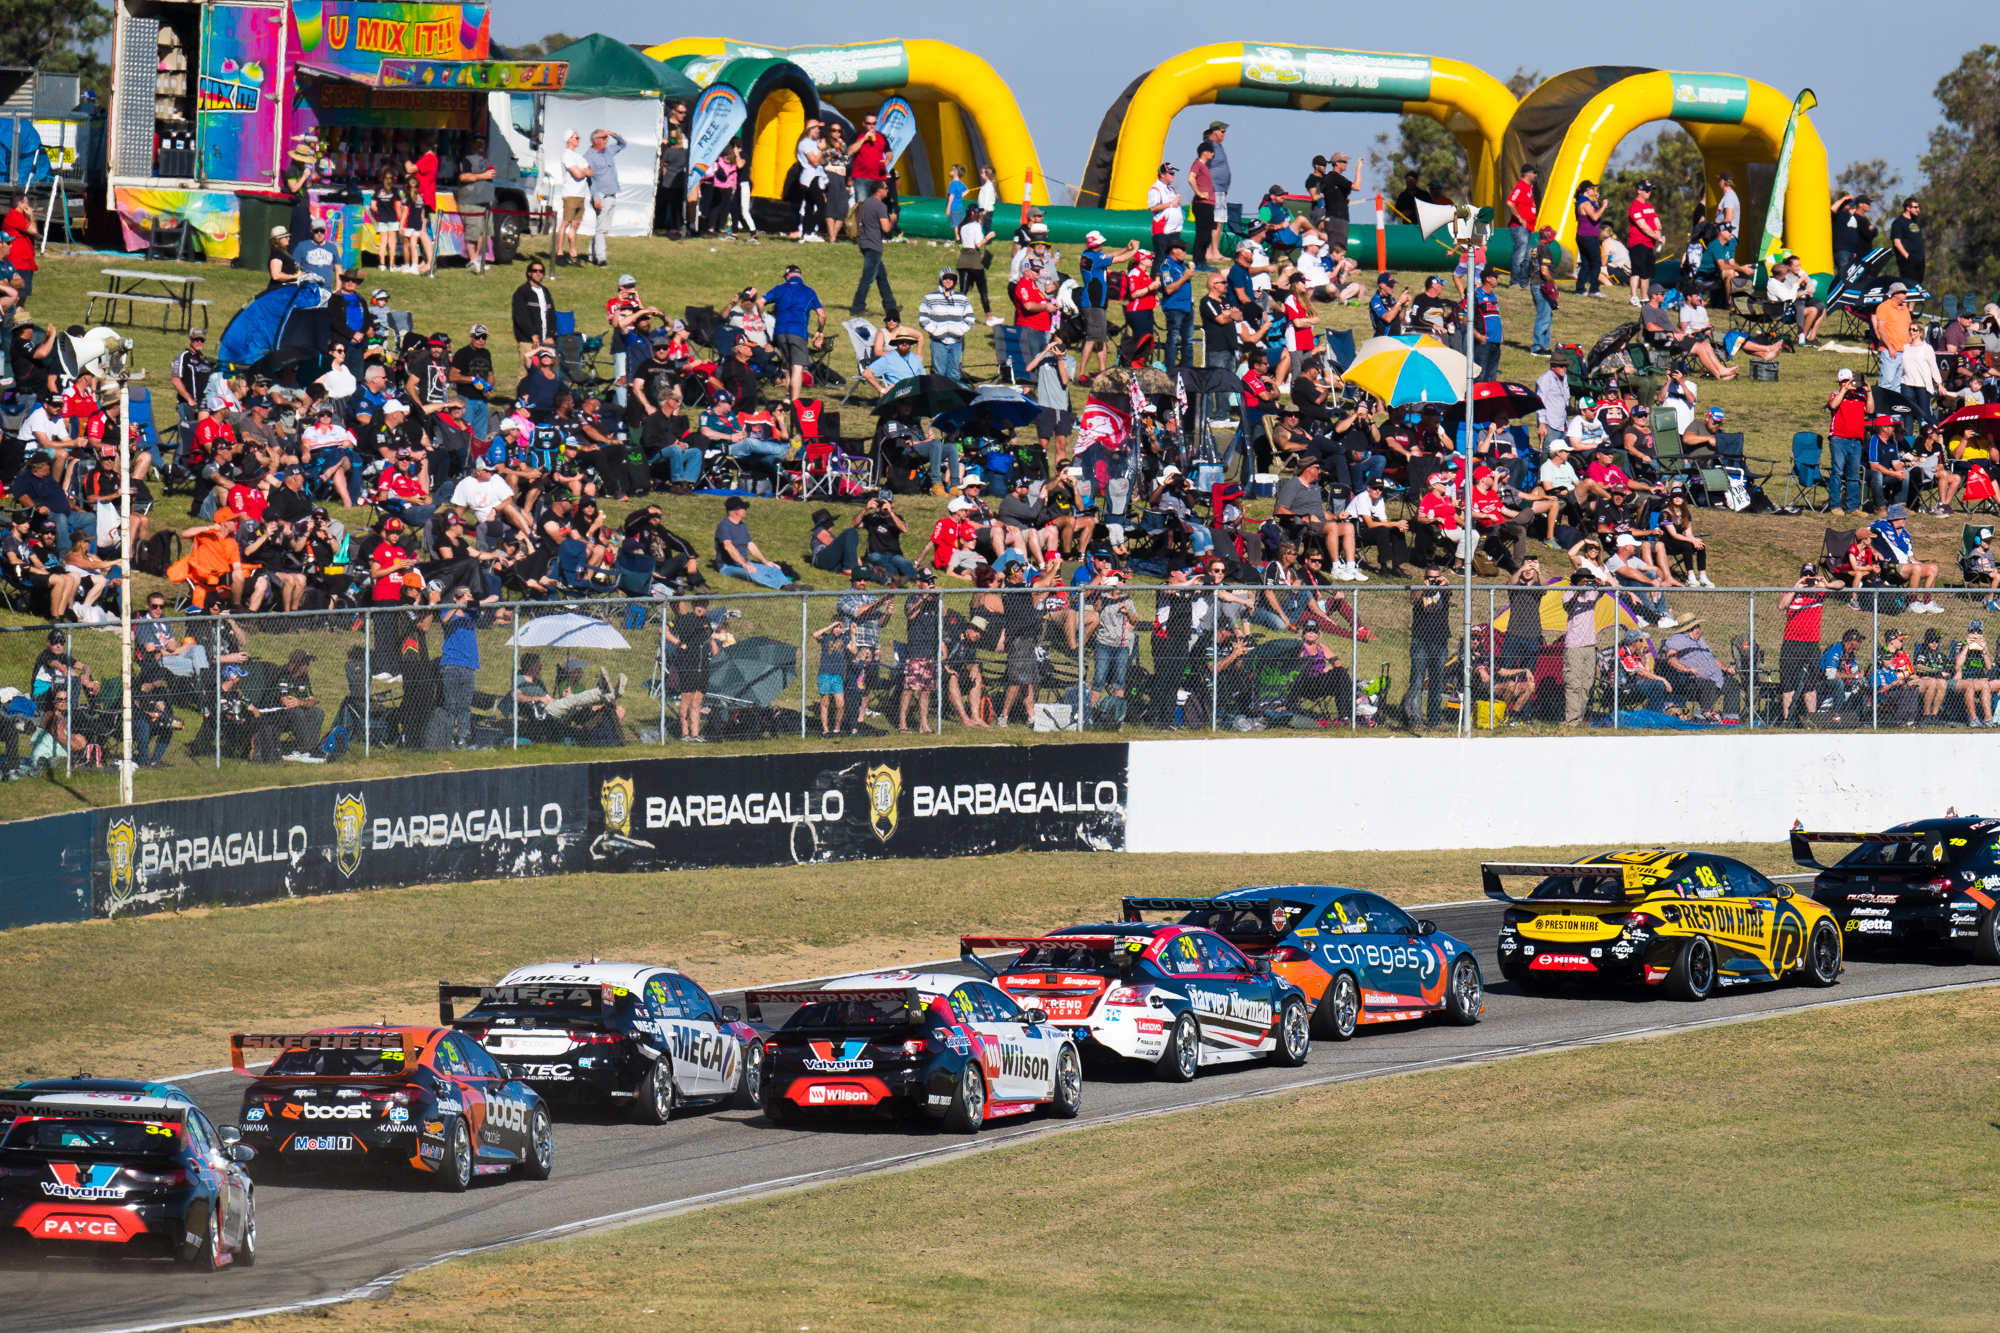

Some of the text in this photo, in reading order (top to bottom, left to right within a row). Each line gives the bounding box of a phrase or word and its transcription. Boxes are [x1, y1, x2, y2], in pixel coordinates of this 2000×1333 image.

[328, 15, 454, 56] U MIX IT!!
[1335, 73, 1358, 88] 749
[1358, 75, 1379, 89] 165
[320, 83, 368, 110] START
[427, 91, 469, 112] HERE
[697, 120, 720, 149] FREE
[913, 780, 1118, 817] BARBAGALLO
[645, 789, 845, 829] BARBAGALLO
[372, 802, 563, 851] BARBAGALLO
[141, 825, 308, 872] BARBAGALLO
[1949, 837, 1967, 847] 19
[1538, 866, 1620, 875] TOYOTA
[1695, 865, 1717, 888] 18
[1129, 899, 1270, 911] coregas
[1333, 901, 1348, 924] 8
[1850, 907, 1890, 917] Haltech
[1545, 919, 1599, 931] PRESTON HIRE
[1736, 907, 1765, 939] HIRE
[990, 938, 1088, 950] Lenovo
[1178, 935, 1198, 959] 78
[1611, 946, 1634, 954] FUCHS
[1323, 943, 1420, 974] coregas
[1553, 956, 1589, 964] HINO
[1006, 976, 1040, 986] Snap-on
[1062, 976, 1101, 986] Snap-on
[480, 987, 592, 1001] MEGA
[756, 991, 907, 1003] PAYNTER DIXON
[953, 989, 974, 1012] 33
[1045, 1000, 1083, 1009] TREND
[1188, 987, 1272, 1025] Harvey Norman
[632, 1020, 662, 1036] MEGA
[1138, 1020, 1162, 1032] Lenovo
[242, 1035, 402, 1049] SKECHERS
[671, 1024, 724, 1073] MEGA
[381, 1051, 405, 1062] 25
[803, 1058, 874, 1070] Valvoline
[1001, 1042, 1049, 1082] Wilson
[826, 1089, 868, 1101] Wilson
[19, 1104, 176, 1123] Wilson Security
[303, 1101, 372, 1119] boost
[483, 1087, 528, 1134] boost
[145, 1125, 173, 1139] 34
[380, 1124, 418, 1133] KAWANA
[294, 1136, 352, 1151] Mobil 1
[40, 1181, 127, 1199] Valvoline
[43, 1219, 118, 1235] PAYCE
